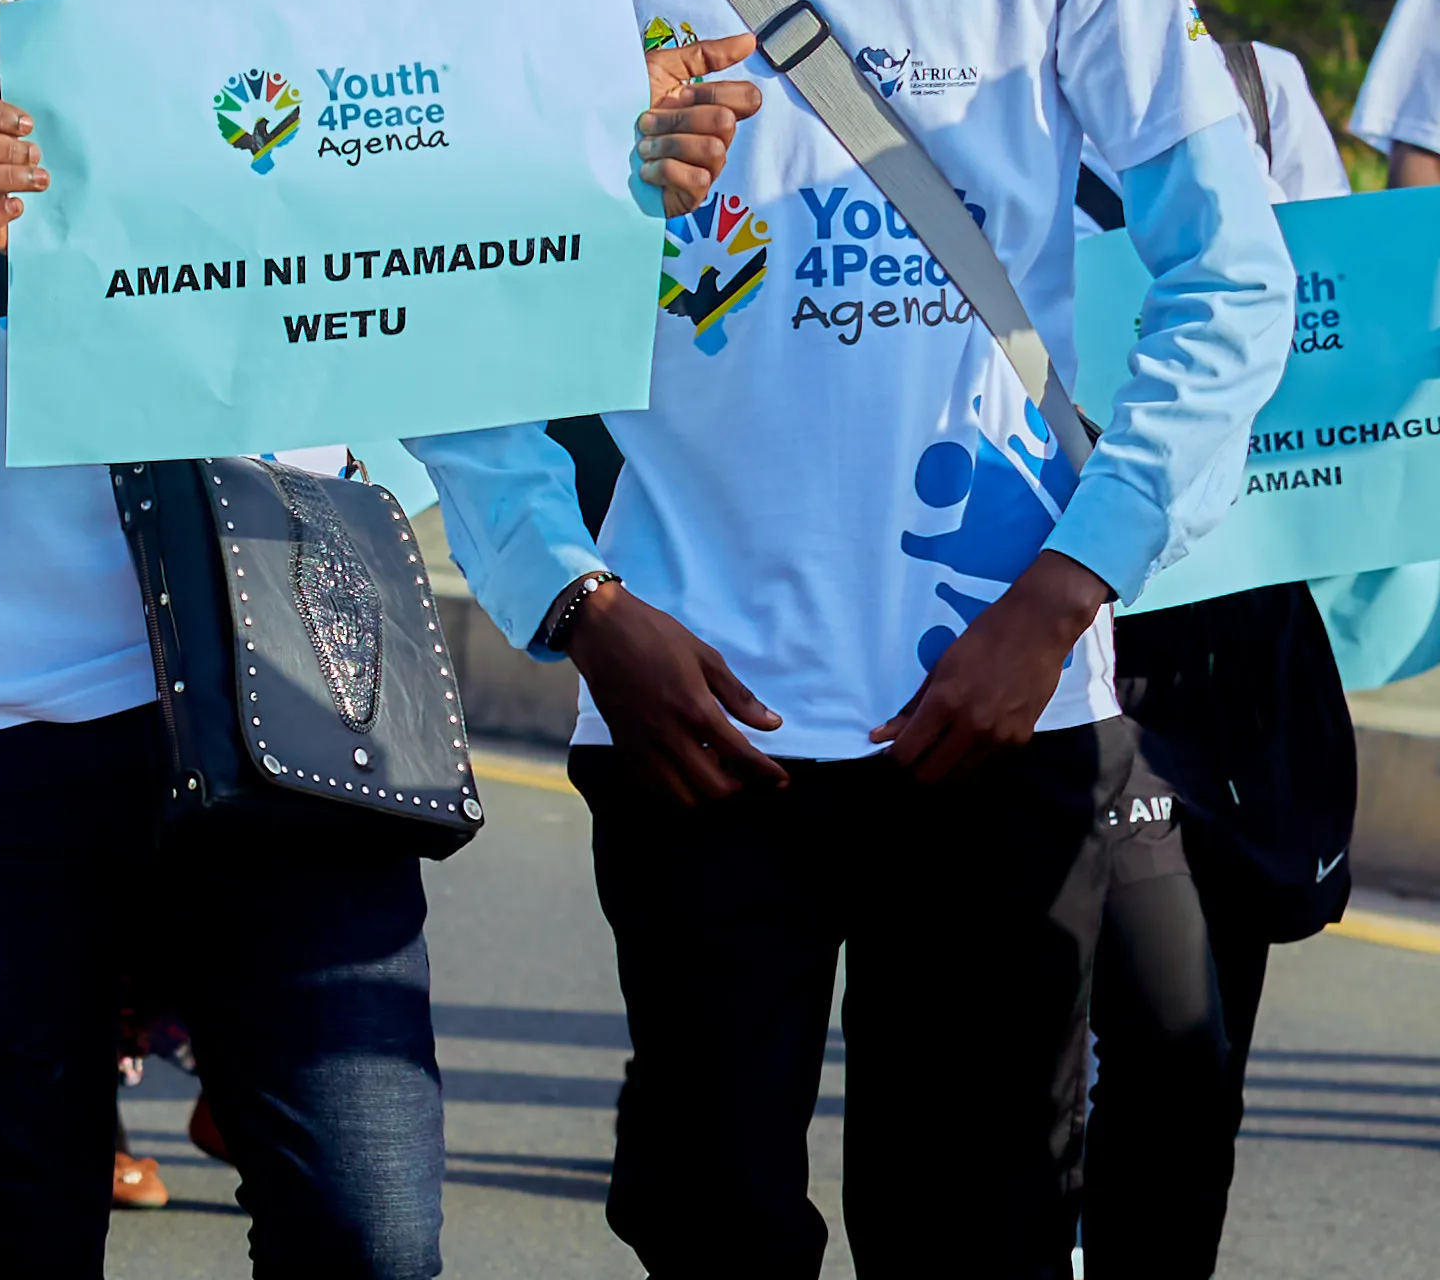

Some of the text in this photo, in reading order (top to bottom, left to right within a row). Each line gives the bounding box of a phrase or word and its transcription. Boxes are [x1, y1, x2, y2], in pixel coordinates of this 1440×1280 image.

[317, 61, 441, 102] Youth
[910, 67, 978, 81] AFRICAN
[317, 101, 445, 132] 4Peace
[317, 126, 451, 167] Agenda
[104, 233, 582, 300] AMANI NI UTAMADUNI
[795, 244, 951, 287] 4Peac
[283, 307, 408, 345] WETU
[1246, 467, 1342, 495] AMANI
